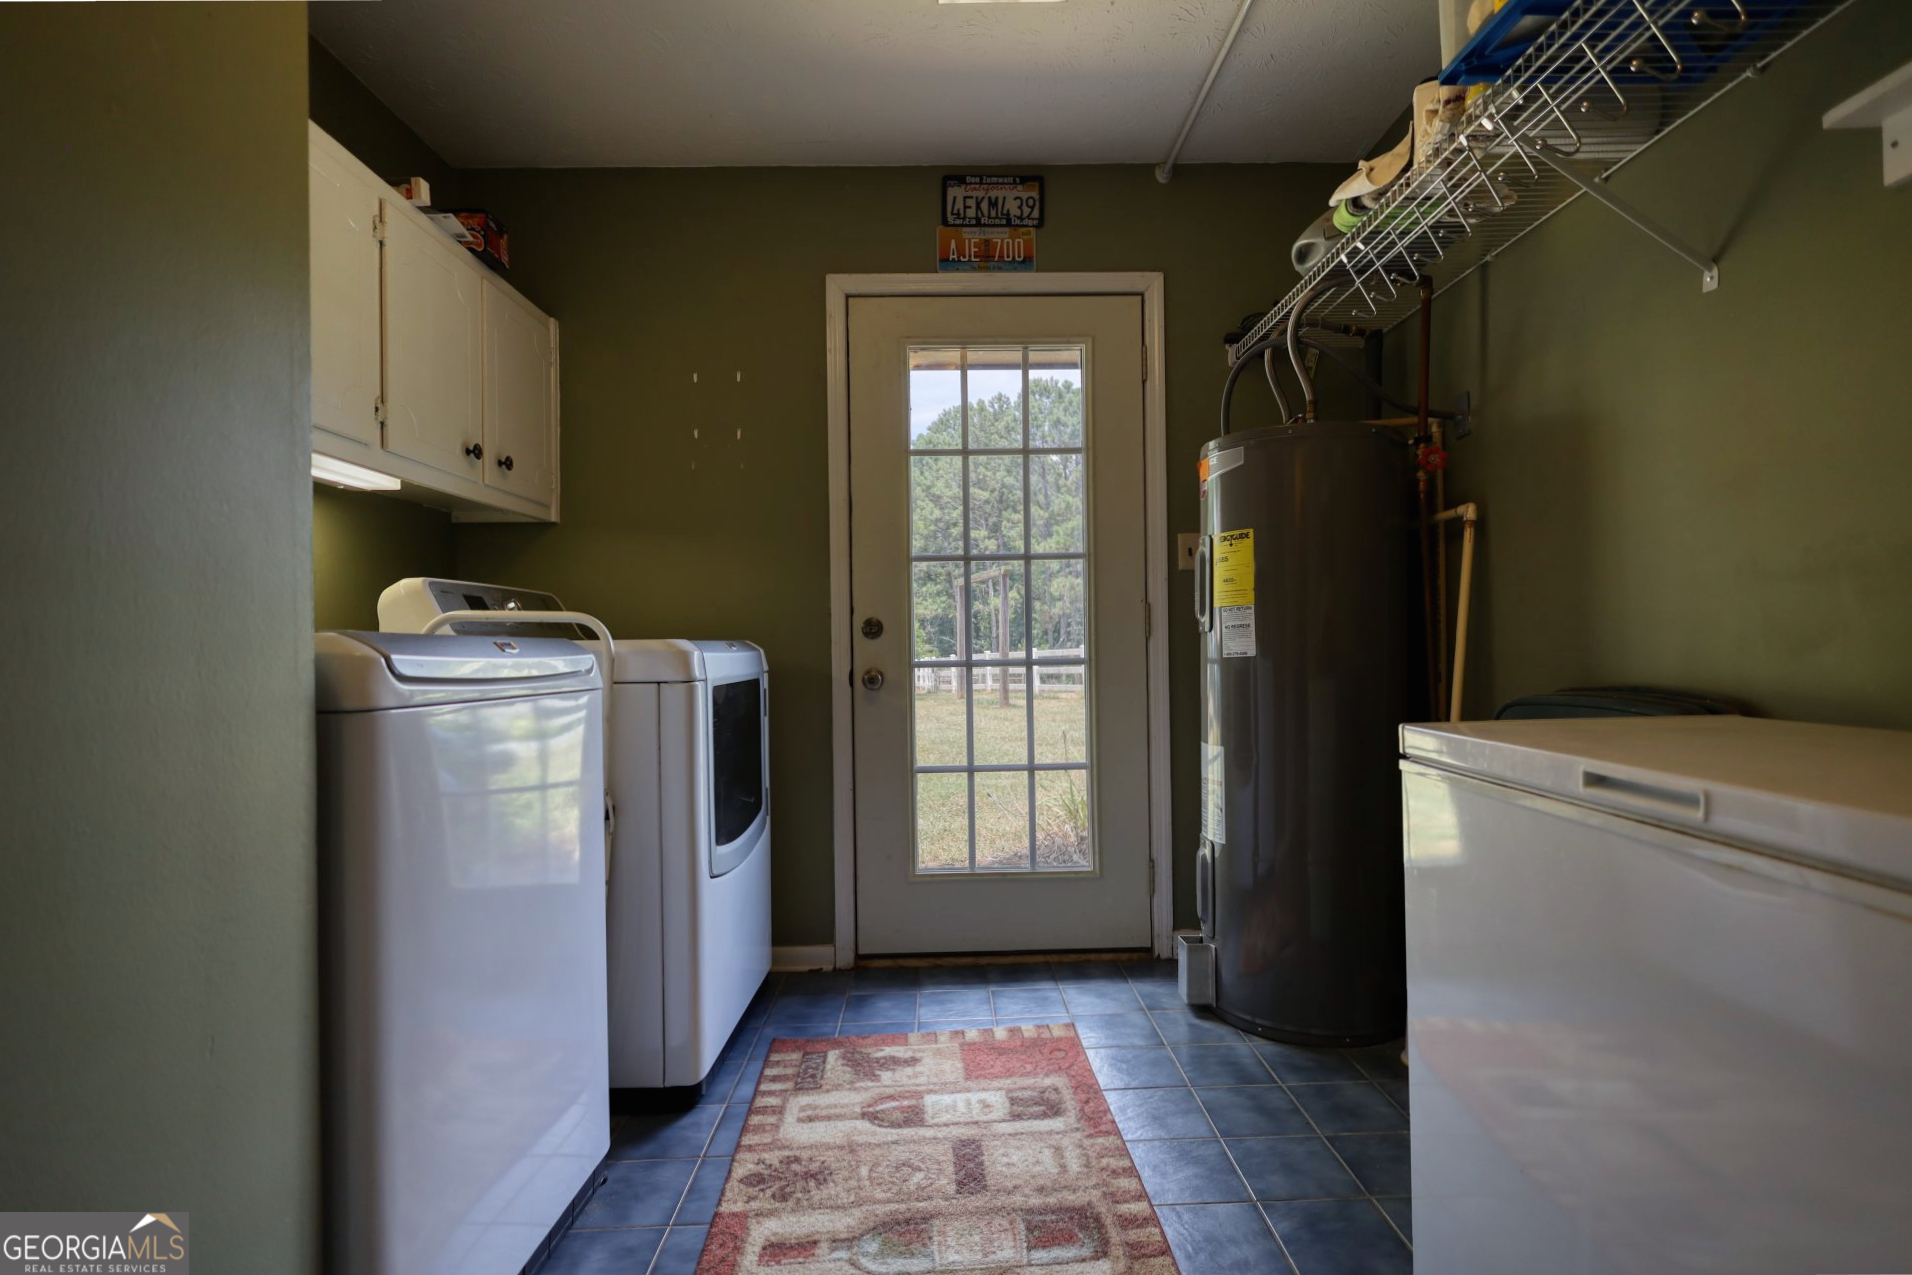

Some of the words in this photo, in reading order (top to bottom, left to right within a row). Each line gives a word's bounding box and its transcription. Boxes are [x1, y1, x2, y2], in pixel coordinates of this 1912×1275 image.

[966, 176, 980, 184] Don
[964, 184, 1024, 195] California
[1011, 218, 1039, 226] Dodge
[949, 239, 980, 262] AJE
[993, 239, 1024, 262] 700
